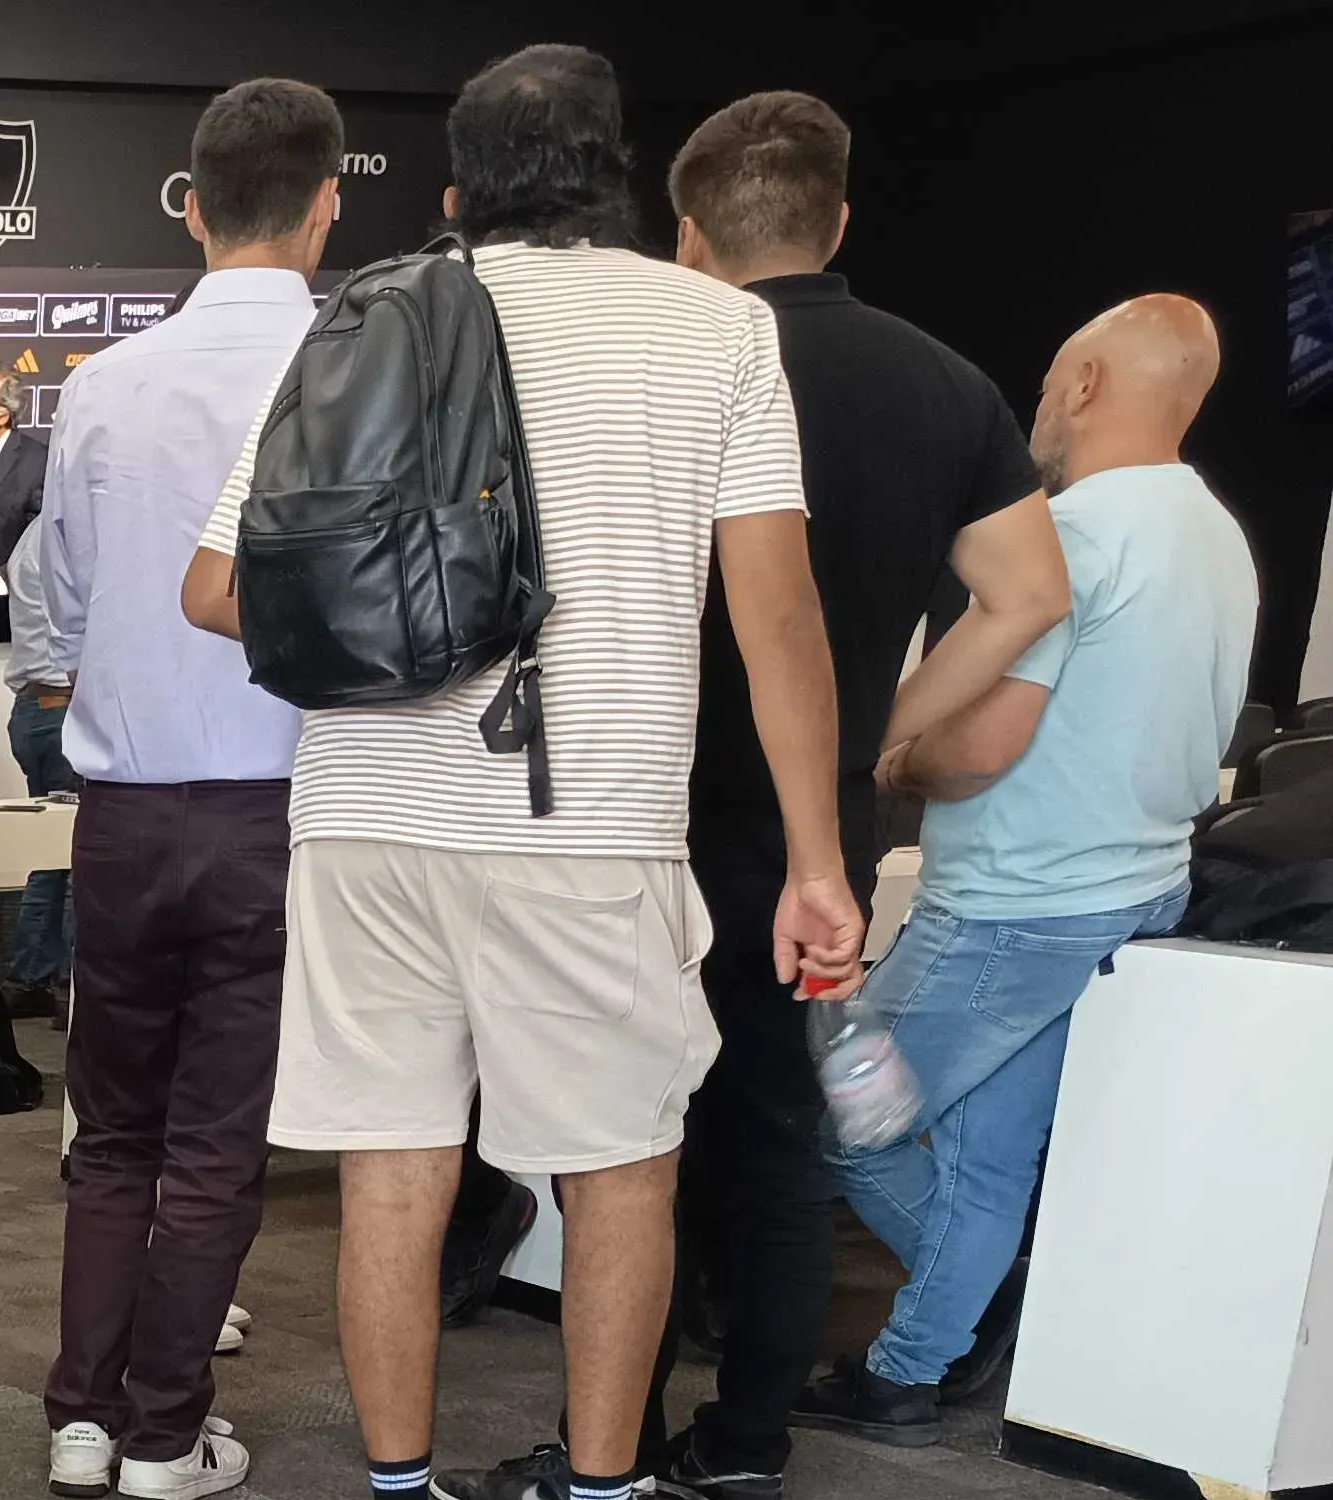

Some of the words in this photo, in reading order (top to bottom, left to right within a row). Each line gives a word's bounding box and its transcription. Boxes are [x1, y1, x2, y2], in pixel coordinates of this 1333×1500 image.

[120, 303, 166, 316] PHILIPS
[121, 317, 132, 327] TV
[133, 317, 139, 327] &
